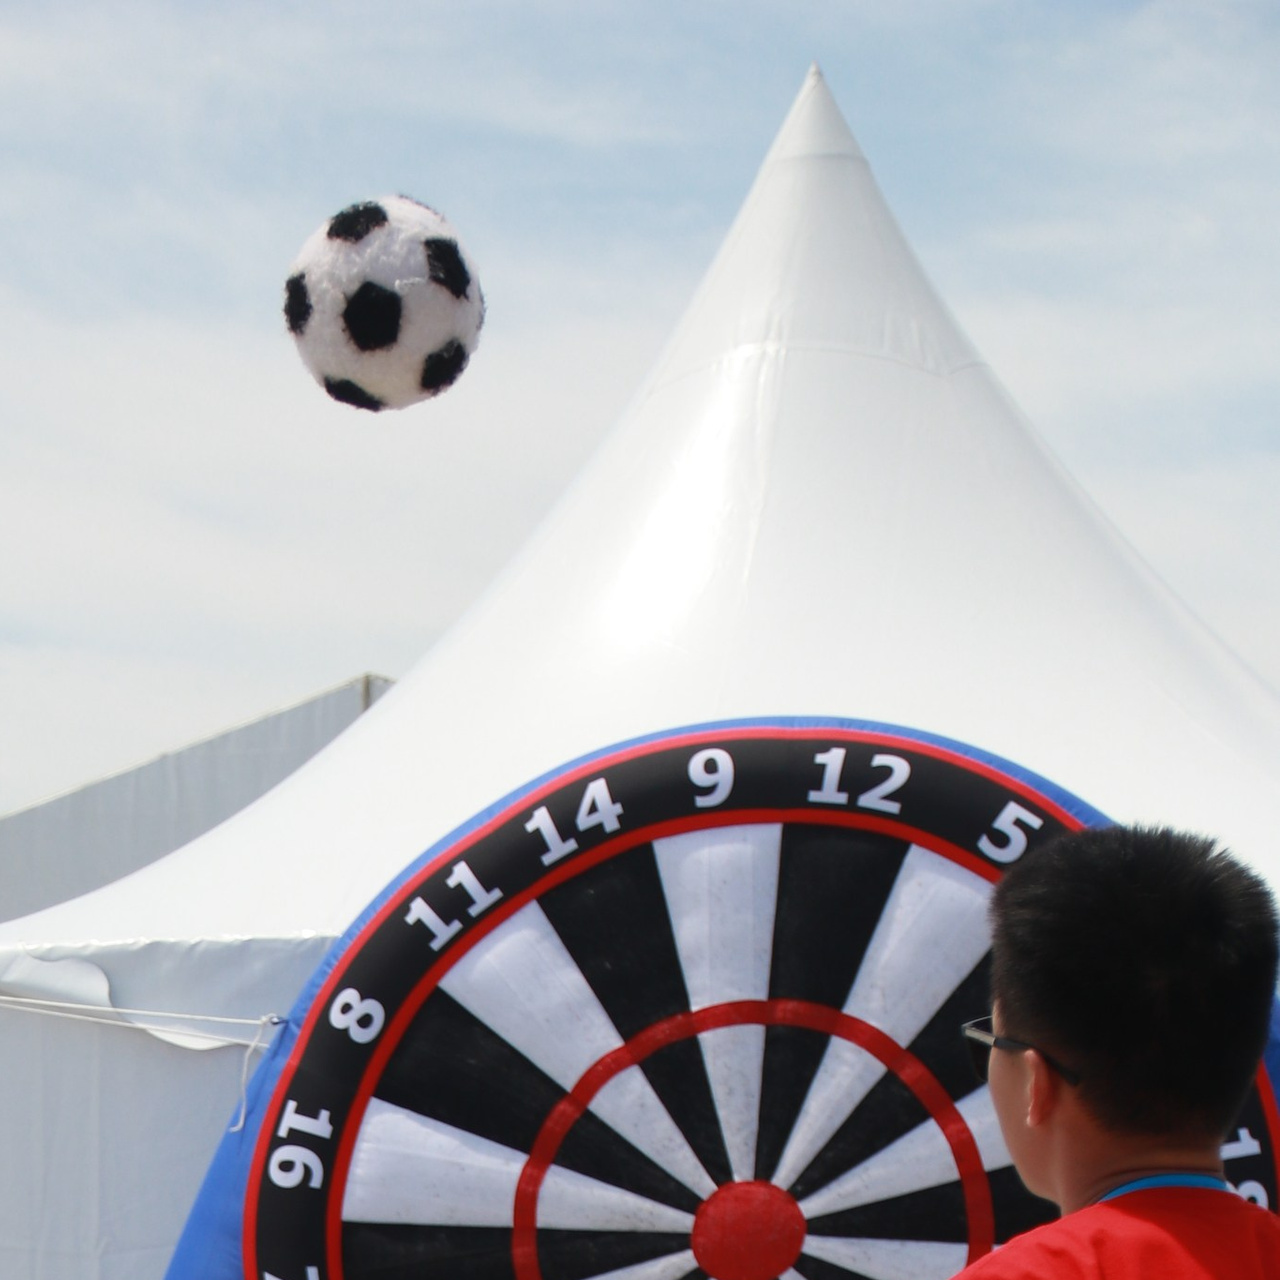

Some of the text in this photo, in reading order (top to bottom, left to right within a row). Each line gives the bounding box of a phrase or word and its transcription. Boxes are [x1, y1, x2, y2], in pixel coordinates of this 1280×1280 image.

[686, 746, 736, 808] 9
[807, 745, 912, 815] 12
[523, 776, 624, 867] 14
[977, 799, 1045, 864] 5
[403, 859, 504, 952] 11
[327, 986, 386, 1045] 8
[267, 1098, 334, 1190] 16
